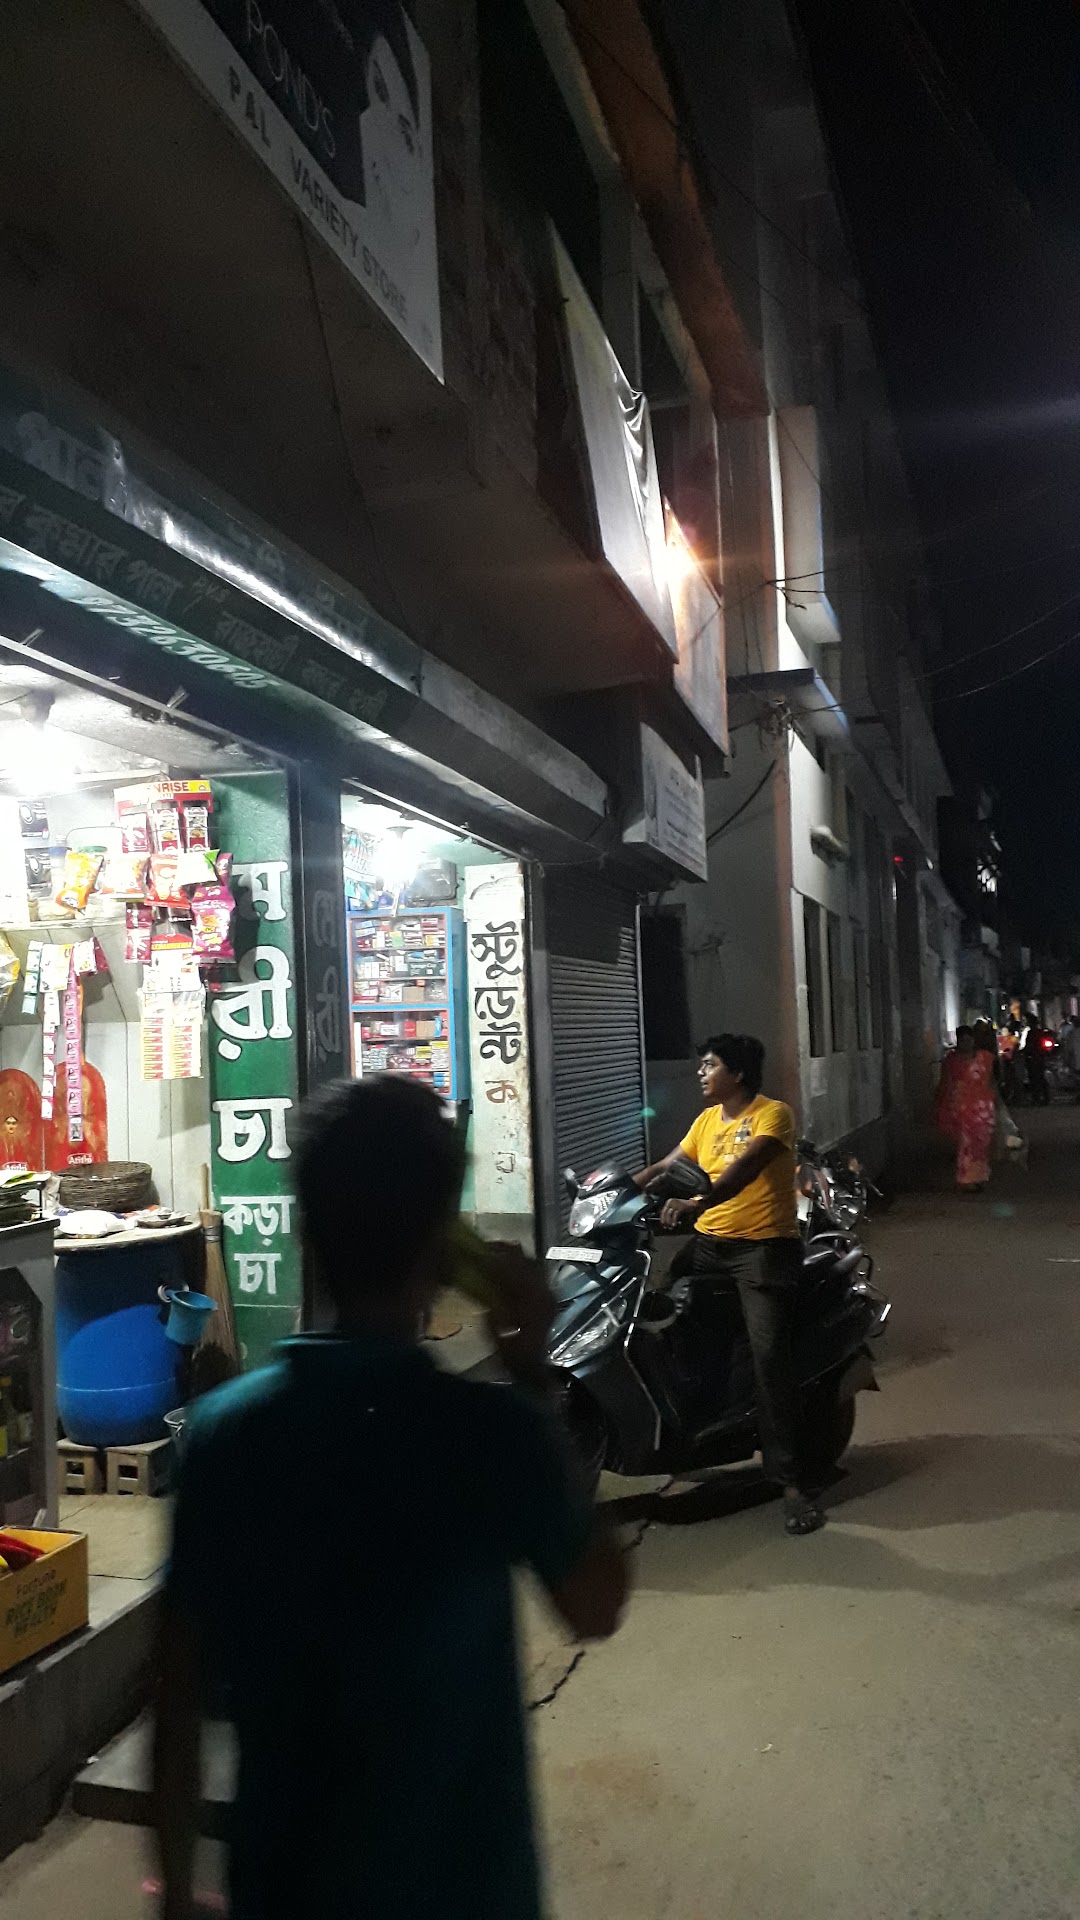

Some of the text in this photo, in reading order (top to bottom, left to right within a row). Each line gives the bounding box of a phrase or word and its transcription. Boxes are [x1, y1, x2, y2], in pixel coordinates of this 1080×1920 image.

[228, 64, 271, 148] PAL
[290, 146, 360, 258] VARIETY
[212, 1097, 293, 1163] চা
[220, 1195, 296, 1247] কড়া
[233, 1252, 282, 1295] চা
